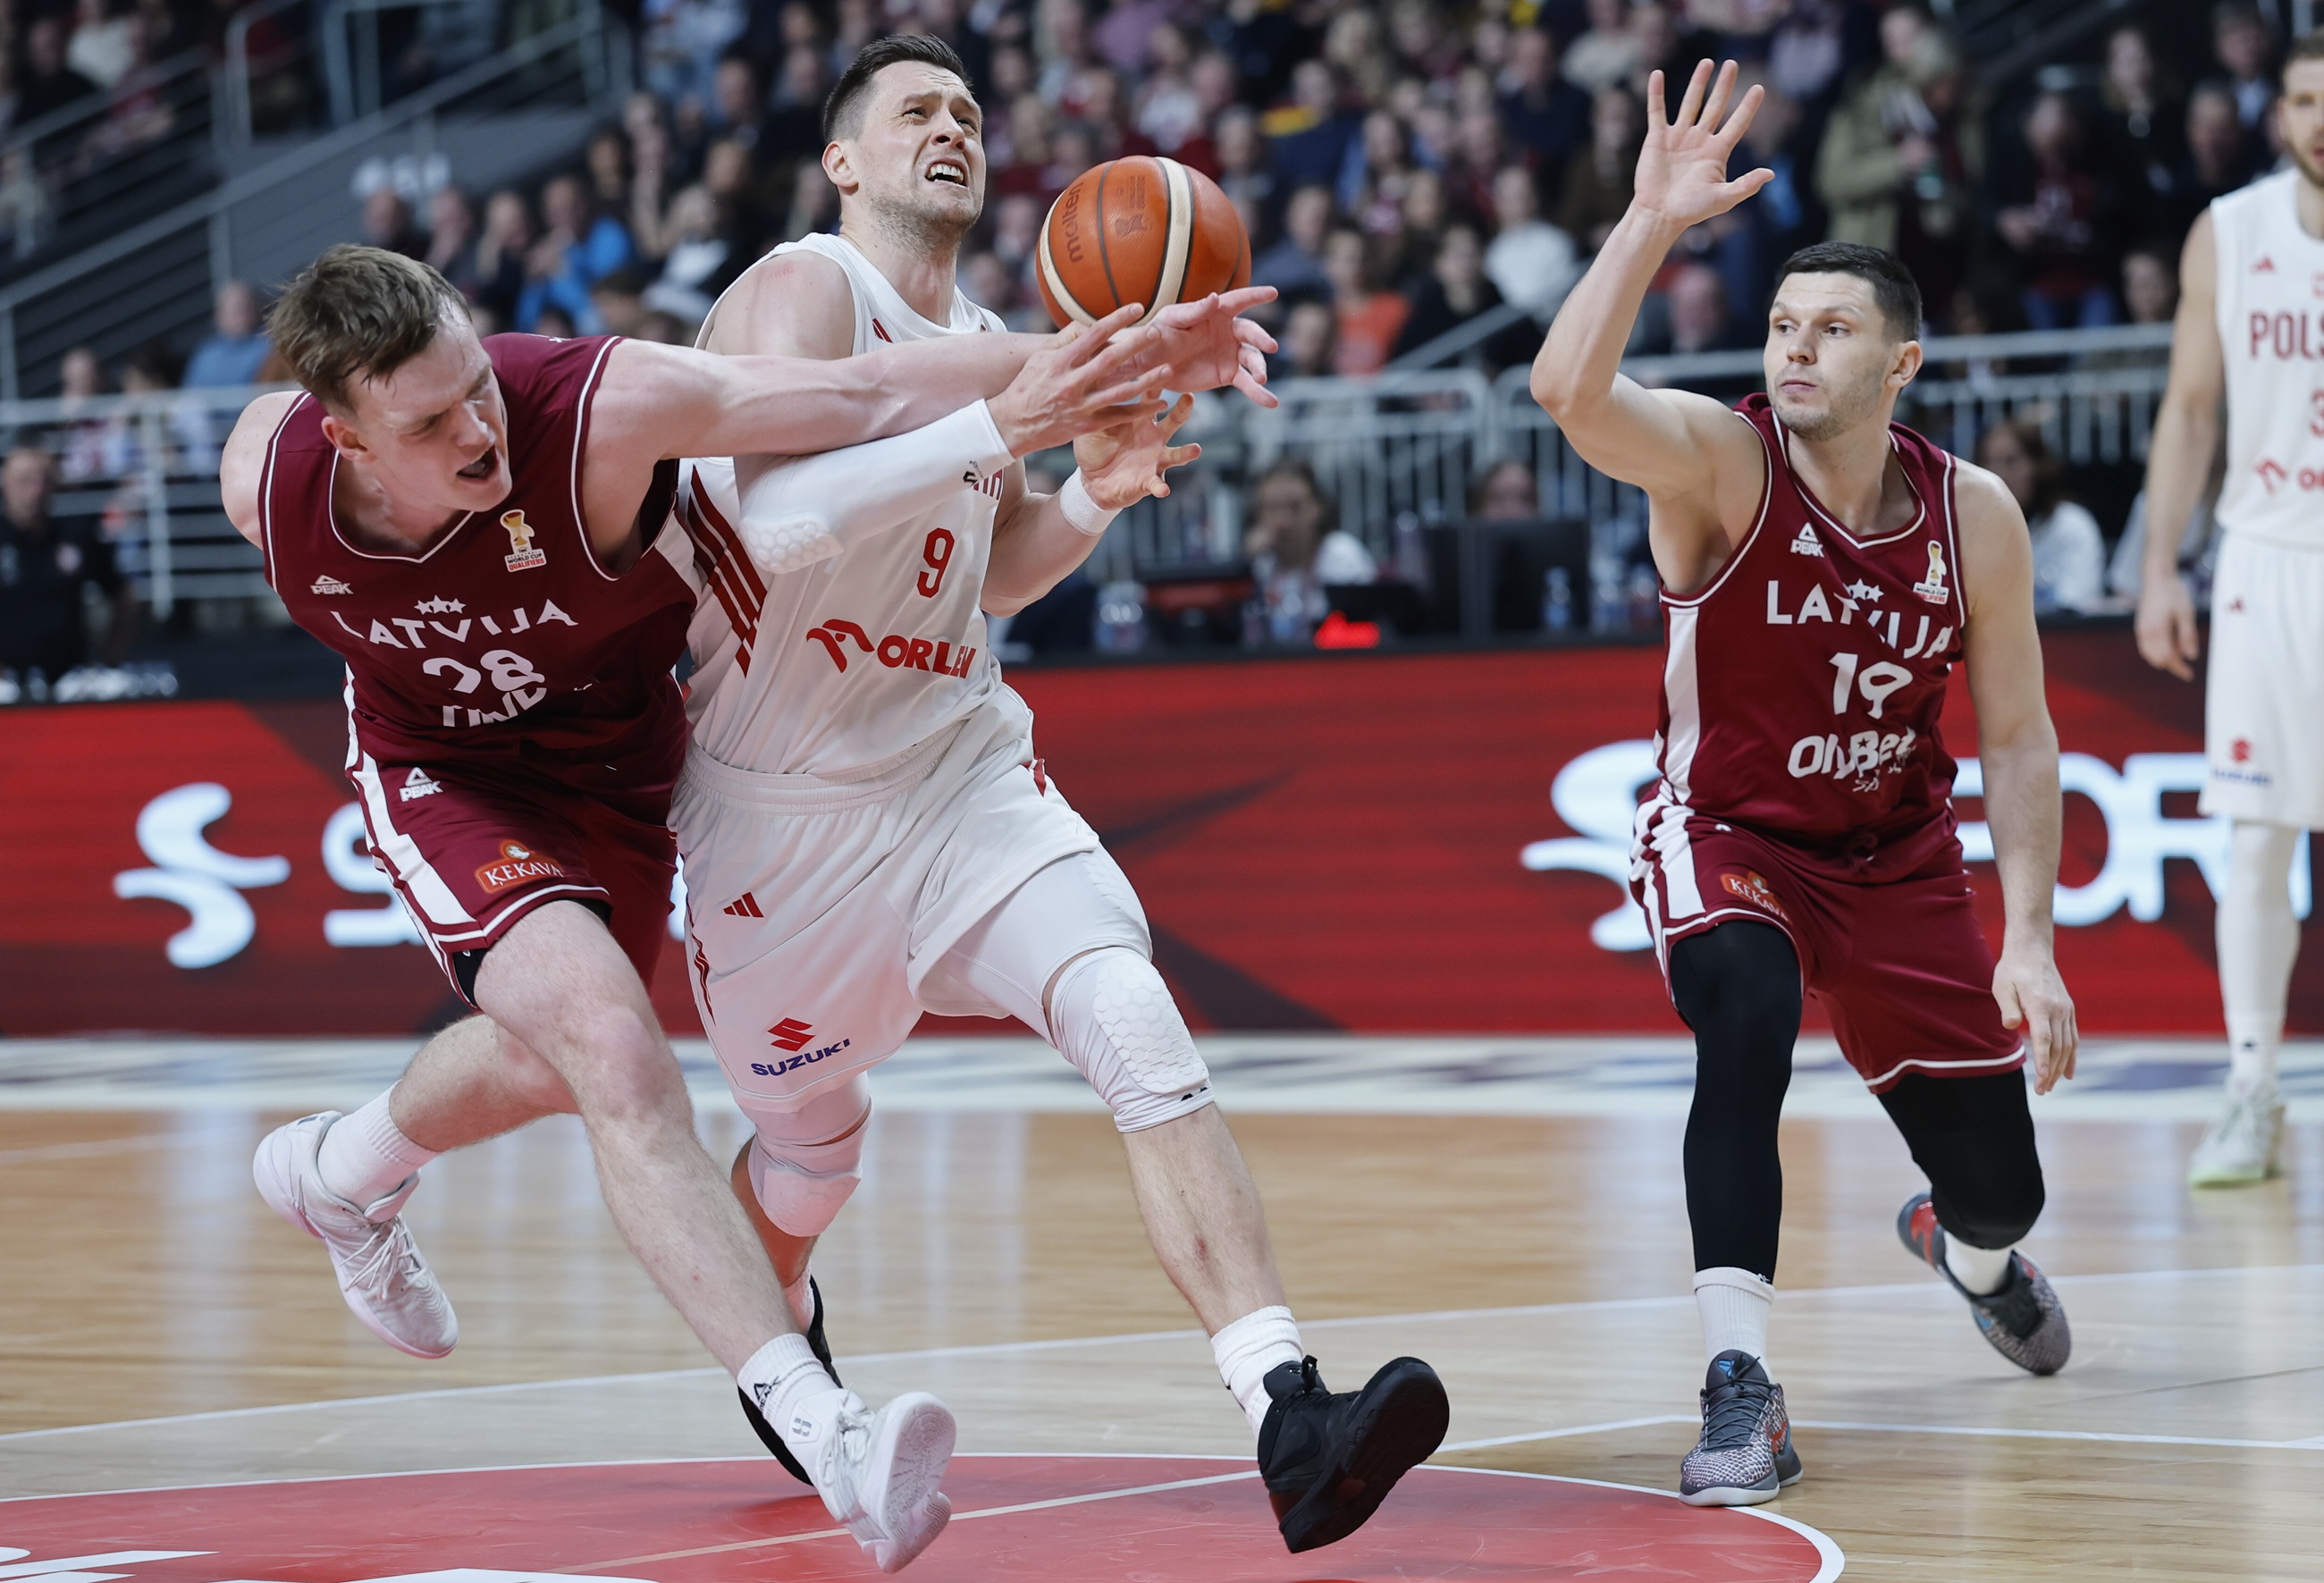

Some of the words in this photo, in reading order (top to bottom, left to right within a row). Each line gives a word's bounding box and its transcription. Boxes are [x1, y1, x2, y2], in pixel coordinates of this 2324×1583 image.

[1062, 181, 1084, 264] molten
[2249, 310, 2324, 360] POL
[507, 555, 530, 564] WORLD
[916, 527, 956, 598] 9
[1790, 539, 1824, 558] PEAK
[509, 558, 544, 571] QUALIFIERS
[309, 583, 354, 594] PEAK
[1828, 653, 1914, 720] 19
[399, 780, 443, 803] PEAK
[751, 1038, 851, 1076] SUZUKI
